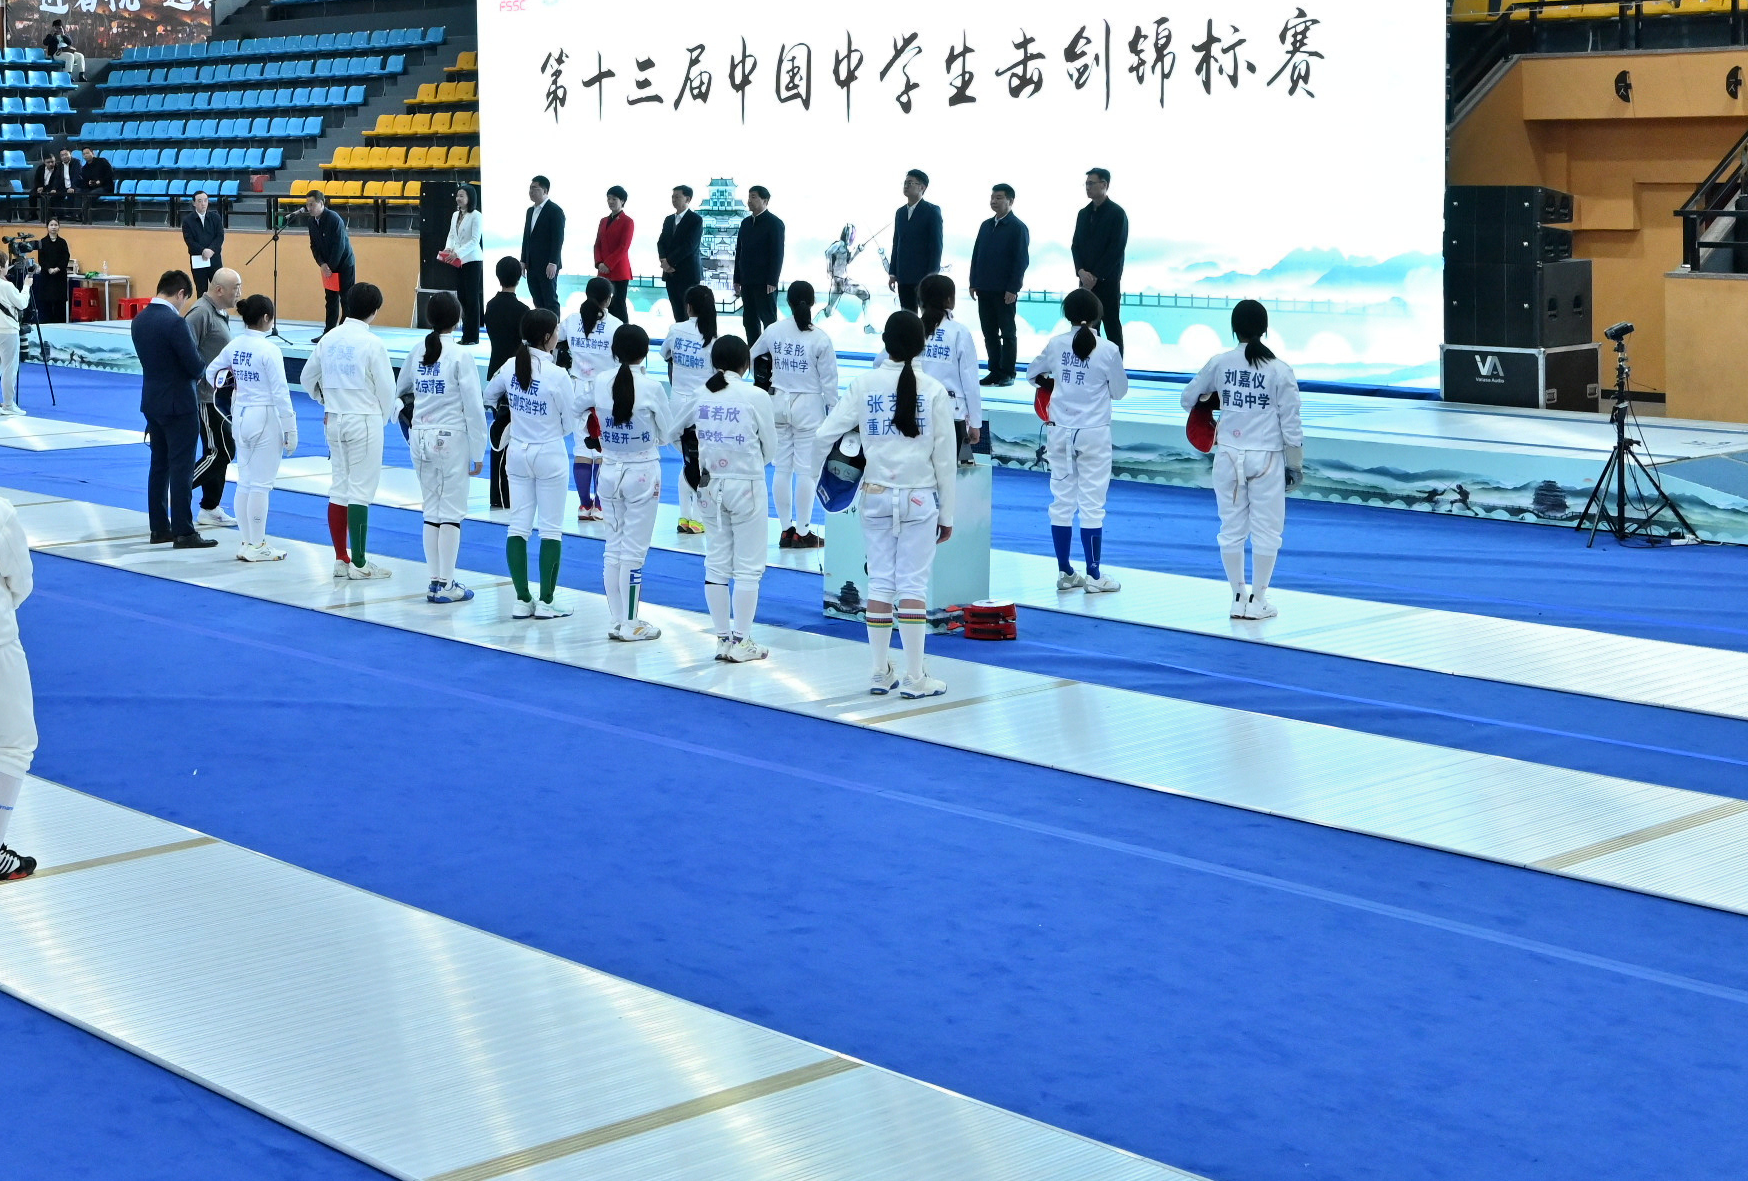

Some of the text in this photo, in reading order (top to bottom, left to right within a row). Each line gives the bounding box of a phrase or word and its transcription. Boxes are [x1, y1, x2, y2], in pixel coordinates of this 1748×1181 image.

[499, 0, 526, 12] FSSC
[540, 8, 1325, 124] 第十三届中国中学生击剑锦标赛
[1061, 368, 1086, 385] 南京
[1224, 369, 1266, 390] 刘嘉仪
[1222, 389, 1270, 409] 青岛中学
